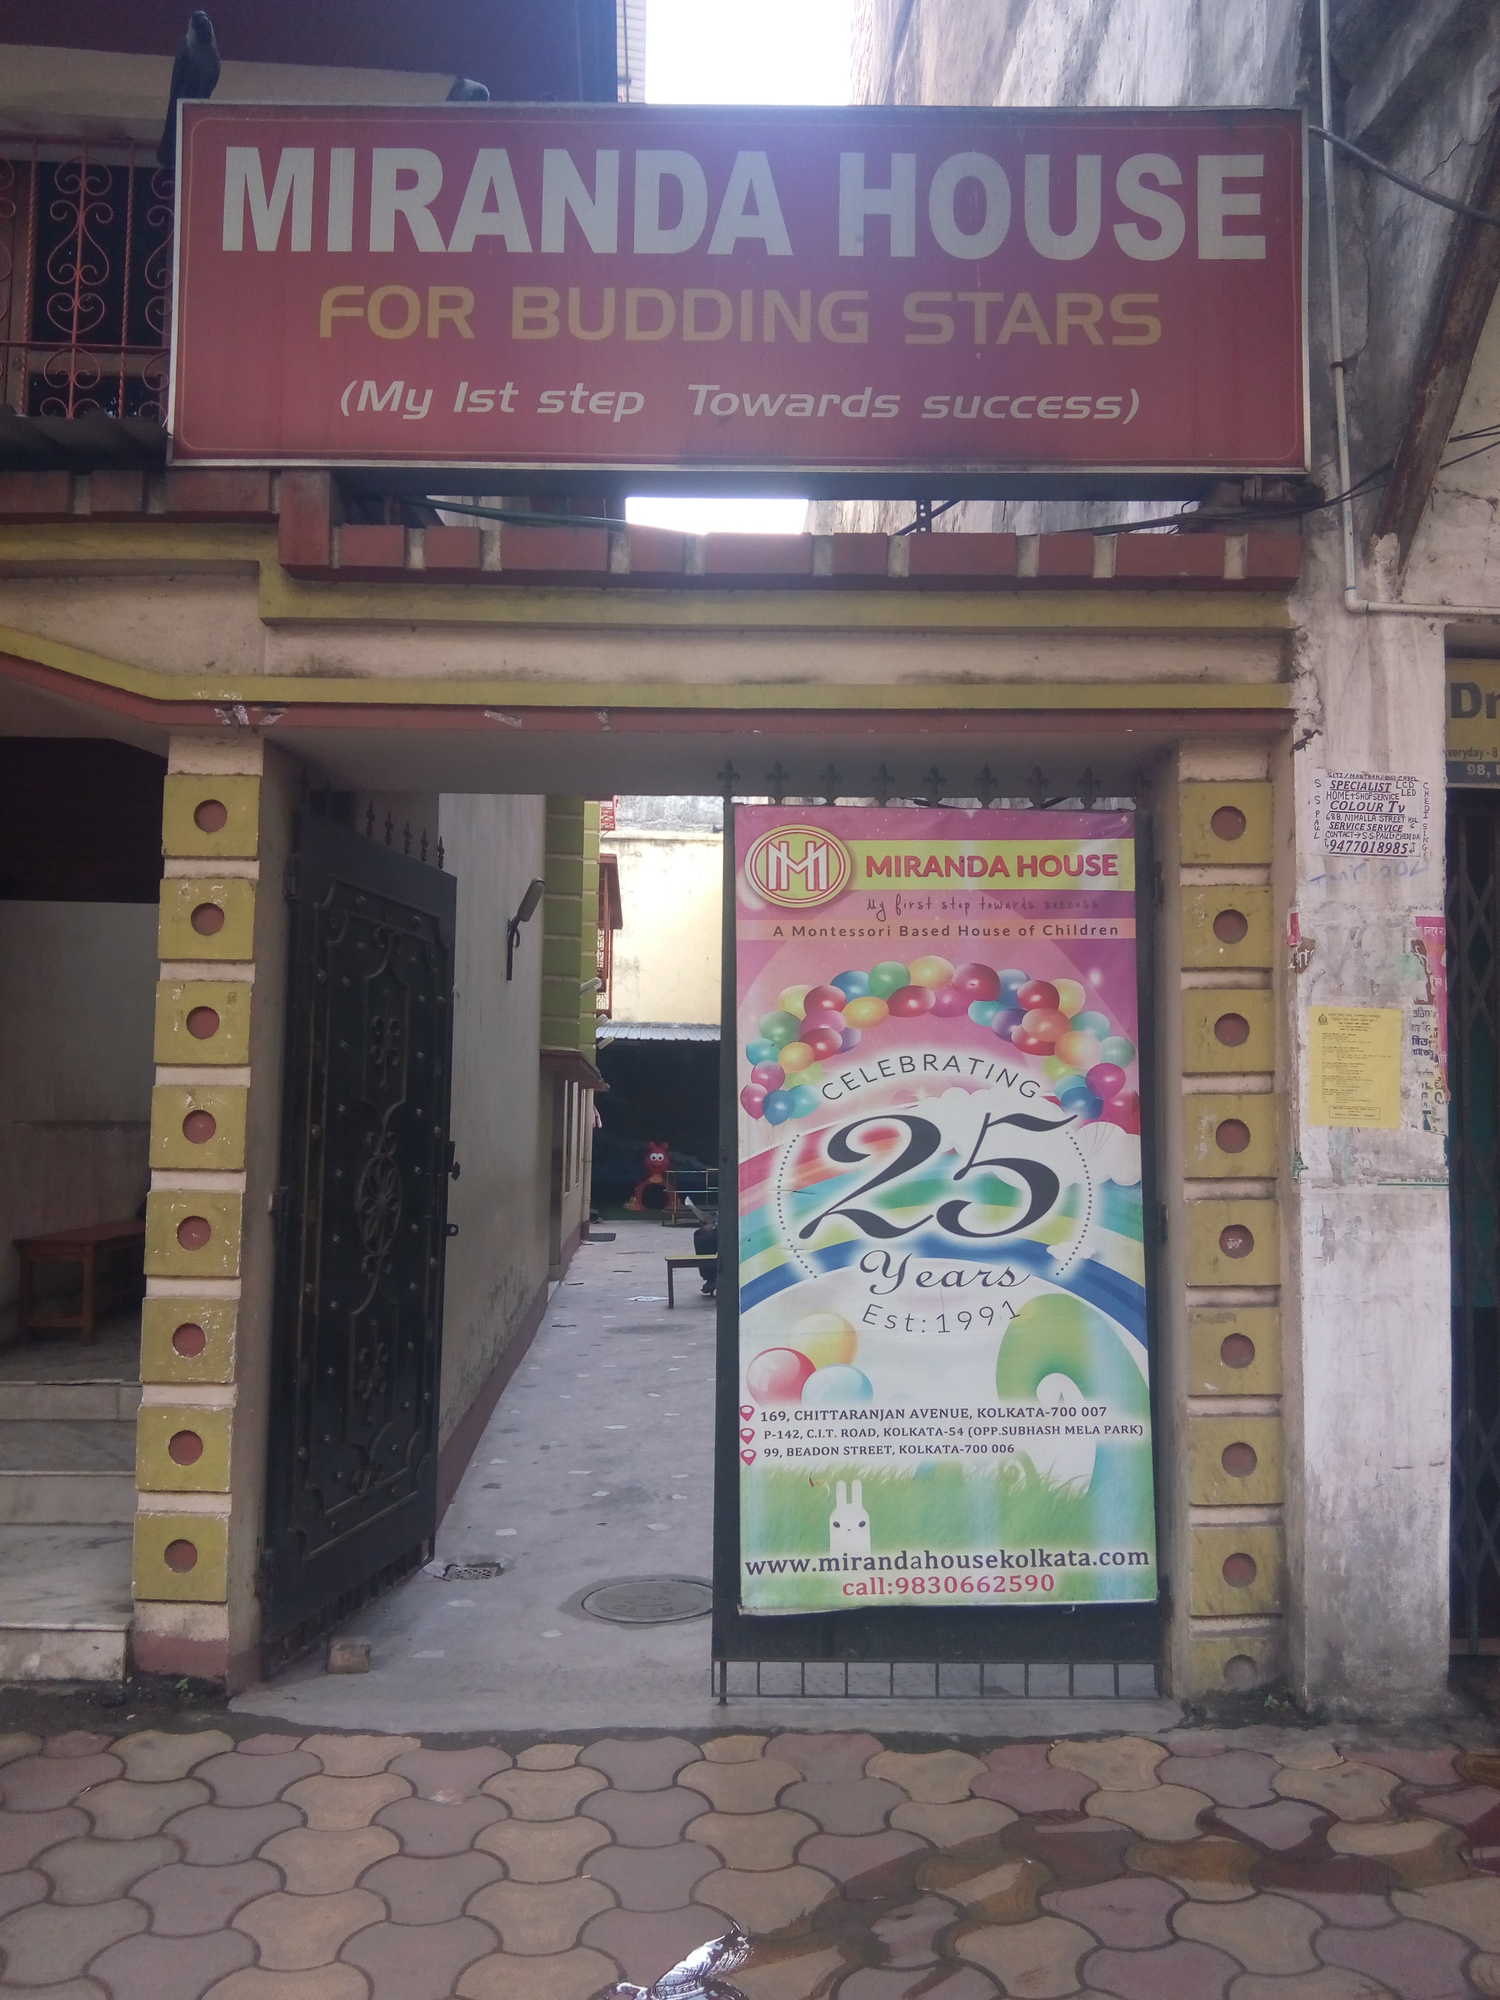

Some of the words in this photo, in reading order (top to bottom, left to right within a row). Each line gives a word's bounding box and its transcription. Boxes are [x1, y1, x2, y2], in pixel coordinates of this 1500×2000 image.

[222, 146, 793, 256] MIRANDA
[838, 151, 1267, 261] HOUSE
[319, 285, 475, 339] FOR
[512, 286, 869, 344] BUDDING
[903, 290, 1163, 347] STARS
[340, 380, 433, 420] (My
[537, 383, 645, 423] step
[688, 384, 901, 419] Towards
[920, 387, 1140, 425] success)
[1330, 800, 1384, 812] COLOUR
[1330, 840, 1409, 854] 9477018985
[866, 854, 1010, 878] MIRANDA
[1017, 854, 1120, 877] HOUSE
[773, 926, 784, 937] A
[792, 925, 891, 937] Montessori
[899, 925, 951, 937] Based
[958, 925, 1010, 937] House
[1018, 924, 1036, 937] of
[1043, 924, 1119, 937] Children
[822, 1053, 1042, 1101] CELEBRATING
[798, 1112, 1079, 1240] 25
[859, 1249, 1031, 1296] Years
[760, 1410, 790, 1423] 169,
[794, 1408, 905, 1422] CHITTARANJAN
[909, 1407, 973, 1420] AVENUE,
[977, 1406, 1077, 1419] KOLKATA-700
[1081, 1406, 1108, 1417] 007
[764, 1428, 803, 1440] P-142,
[841, 1427, 879, 1440] ROAD,
[883, 1426, 964, 1438] KOLKATA-54
[1064, 1425, 1101, 1436] MELA
[1104, 1424, 1144, 1437] PARK)
[764, 1447, 783, 1459] 99,
[786, 1446, 839, 1458] BEADON
[843, 1445, 896, 1457] STREET,
[899, 1443, 988, 1455] KOLKATA-700
[991, 1443, 1015, 1454] 006
[745, 1549, 1150, 1577] www.mirandahousekolkata.com
[842, 1573, 1055, 1597] call:9830662590
